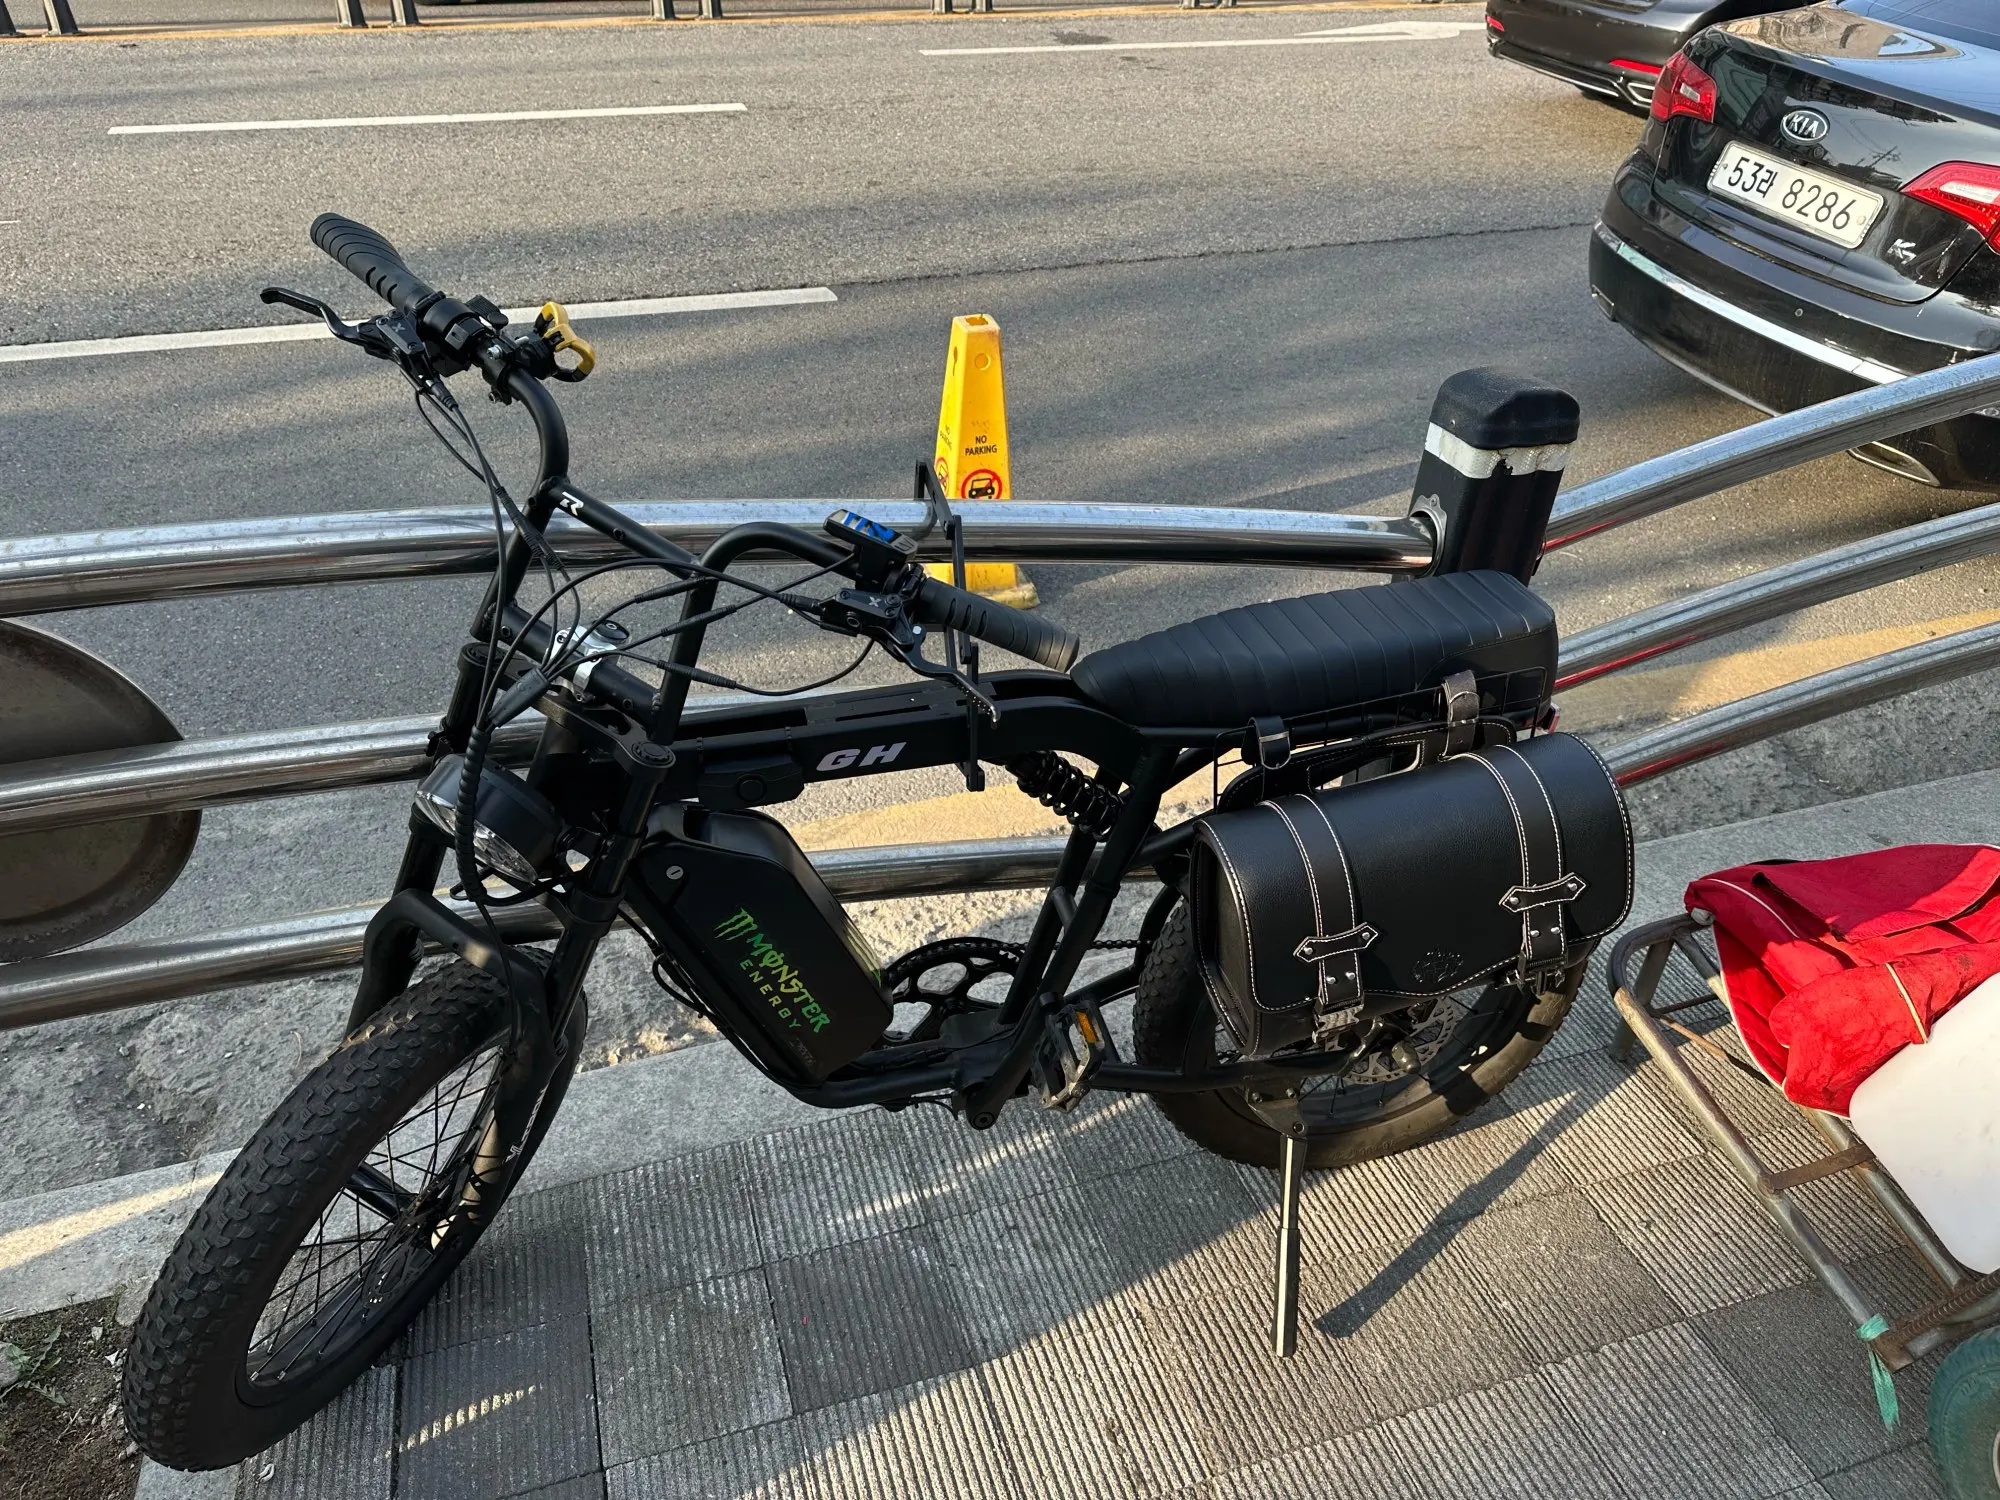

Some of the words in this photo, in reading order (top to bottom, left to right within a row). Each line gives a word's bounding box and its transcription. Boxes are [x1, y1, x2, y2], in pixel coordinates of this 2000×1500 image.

[1789, 113, 1821, 139] KIA
[1727, 156, 1779, 199] 53라
[1781, 178, 1858, 231] 8286
[964, 445, 998, 456] PARKING
[975, 435, 987, 444] NO
[816, 741, 907, 772] GH
[739, 958, 802, 1028] ENERGY
[746, 933, 831, 1033] MONSTER
